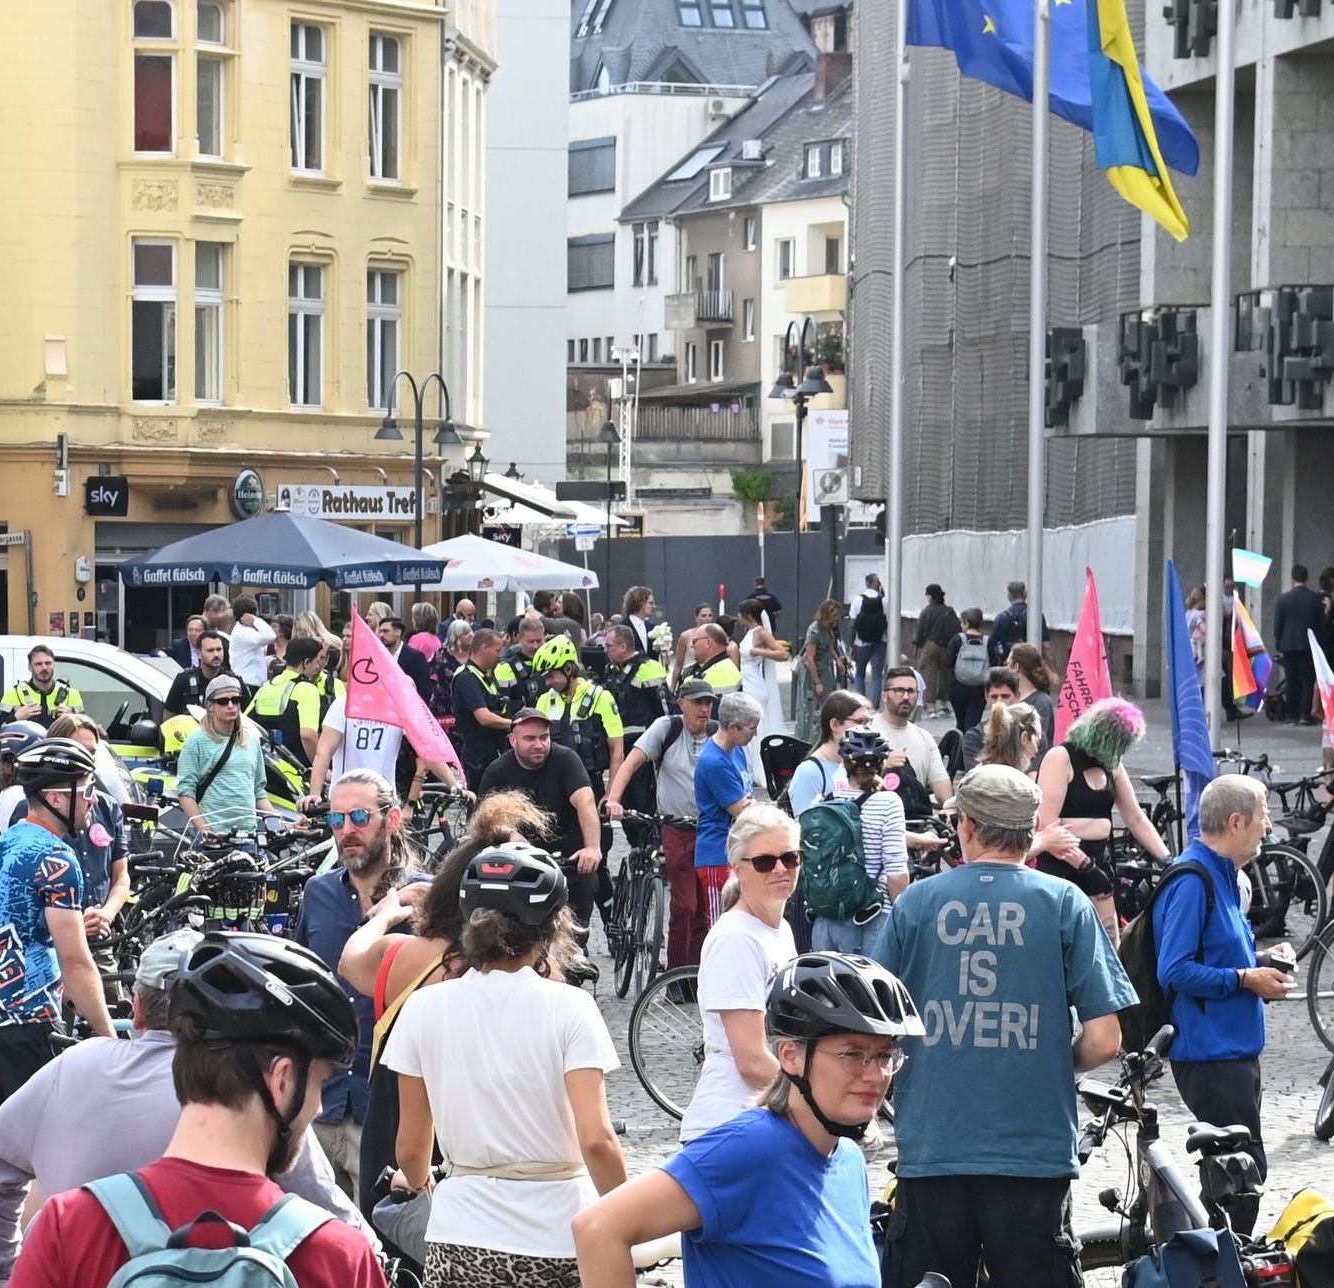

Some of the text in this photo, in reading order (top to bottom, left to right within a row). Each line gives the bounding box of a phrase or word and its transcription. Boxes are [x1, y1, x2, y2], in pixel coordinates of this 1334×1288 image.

[90, 485, 118, 507] sky
[237, 490, 262, 499] Heine
[322, 490, 416, 513] Rathaus Tref
[143, 568, 205, 583] Gaffel Kölsch
[243, 568, 308, 586] Gaffel Kölsch
[1070, 661, 1094, 707] FAHRR
[356, 727, 384, 750] 87
[937, 900, 1026, 946] CAR
[958, 950, 998, 997] IS
[922, 1000, 1039, 1050] OVER!
